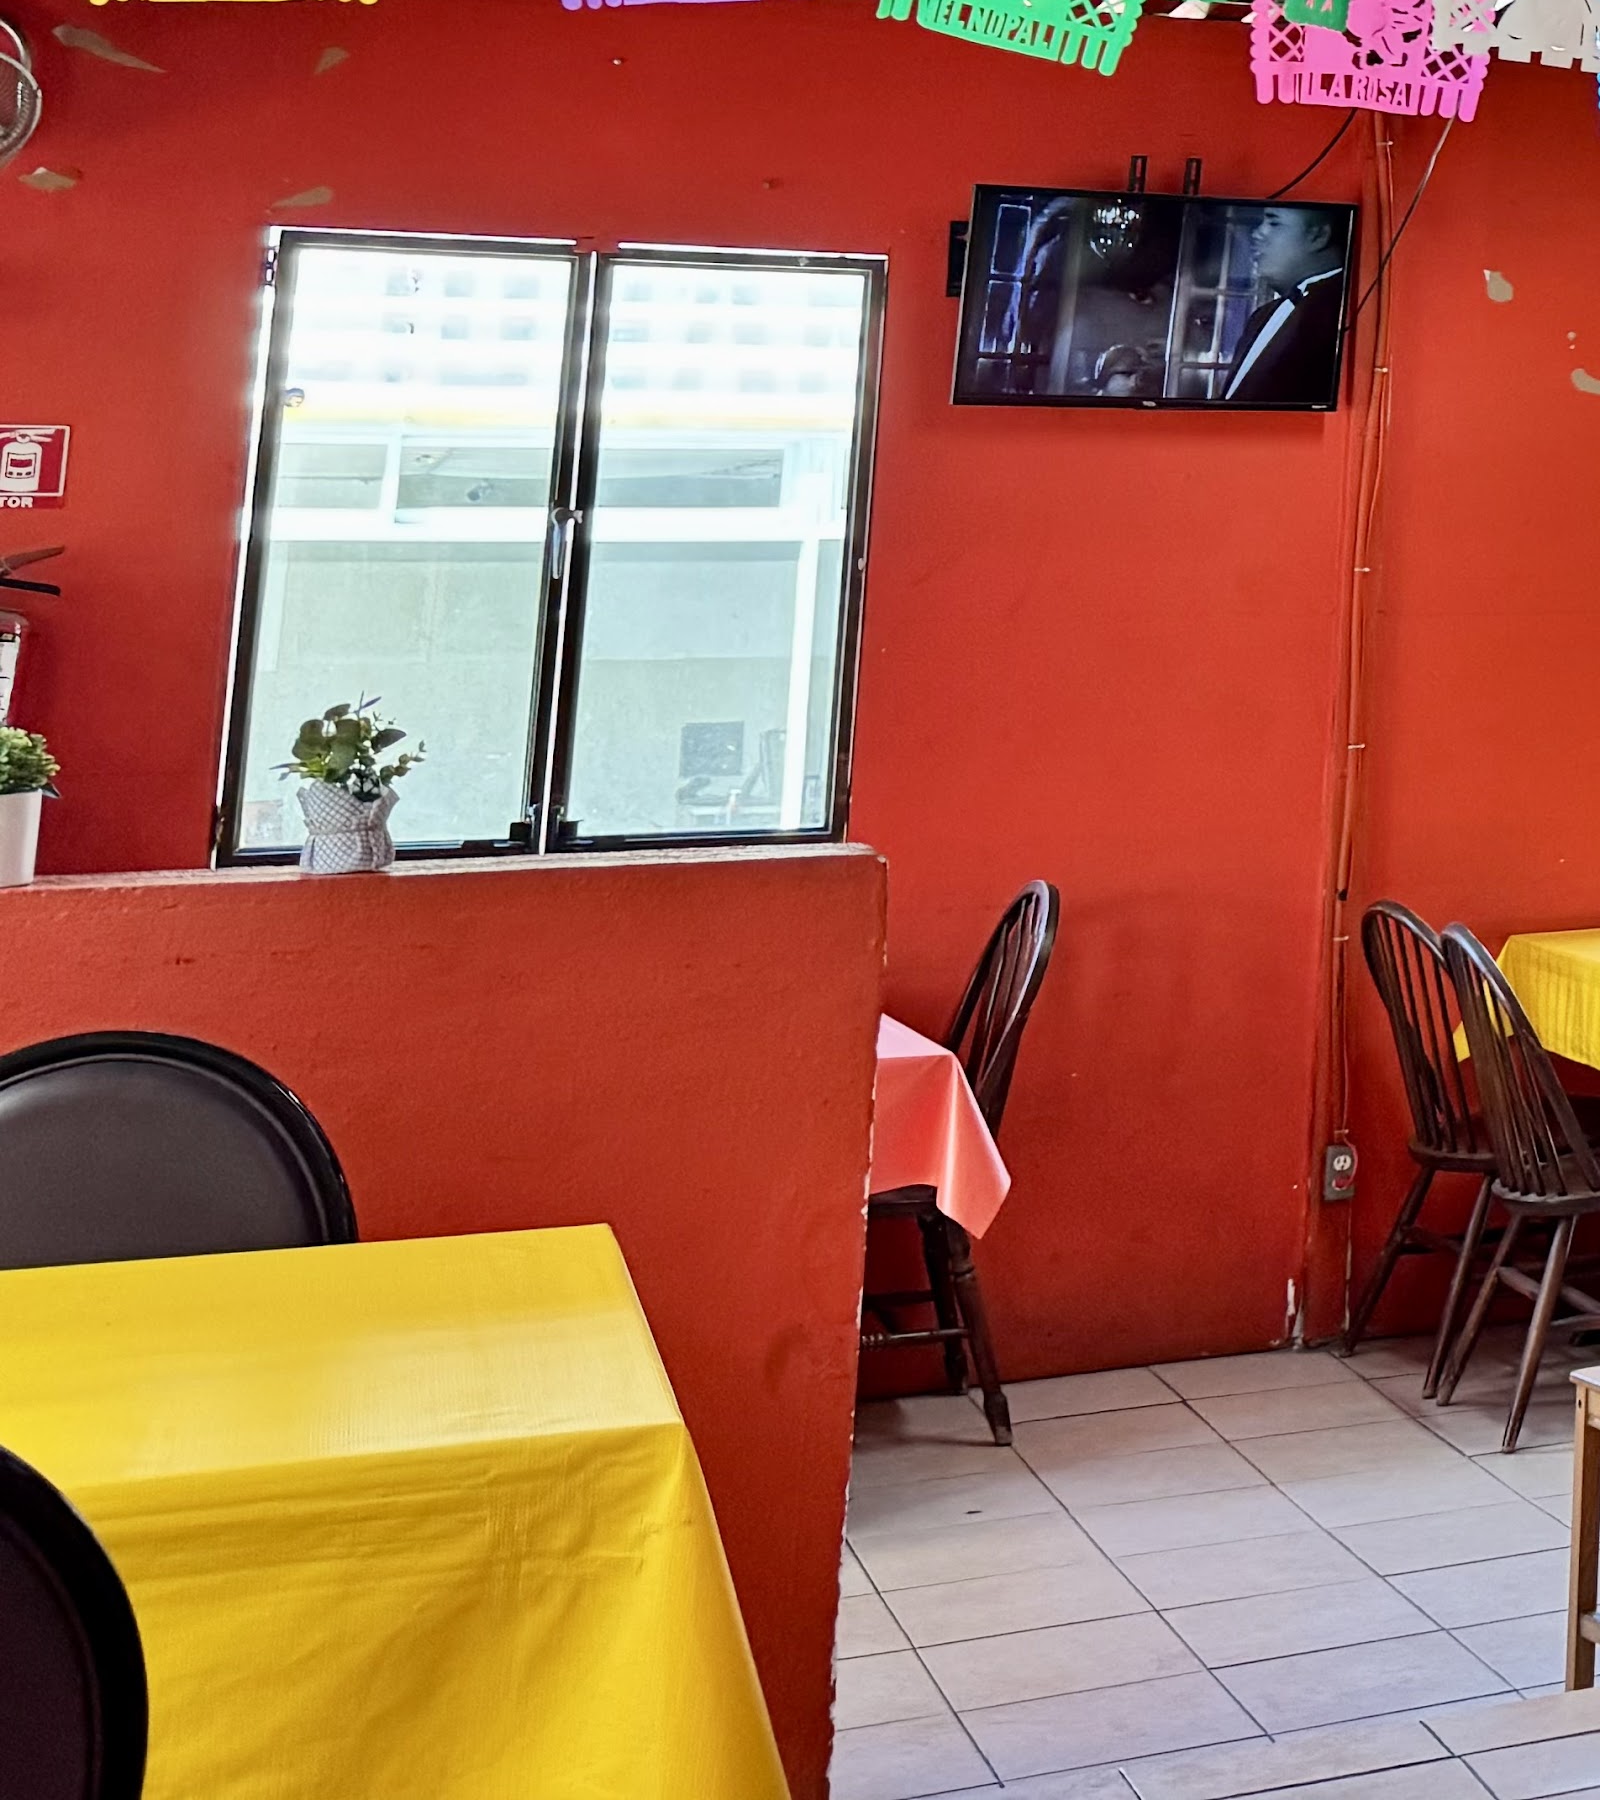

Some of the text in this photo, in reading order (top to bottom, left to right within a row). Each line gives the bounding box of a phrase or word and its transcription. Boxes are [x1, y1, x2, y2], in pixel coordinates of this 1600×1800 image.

[966, 6, 1052, 50] NOPAL
[1311, 72, 1409, 108] LA ROSA
